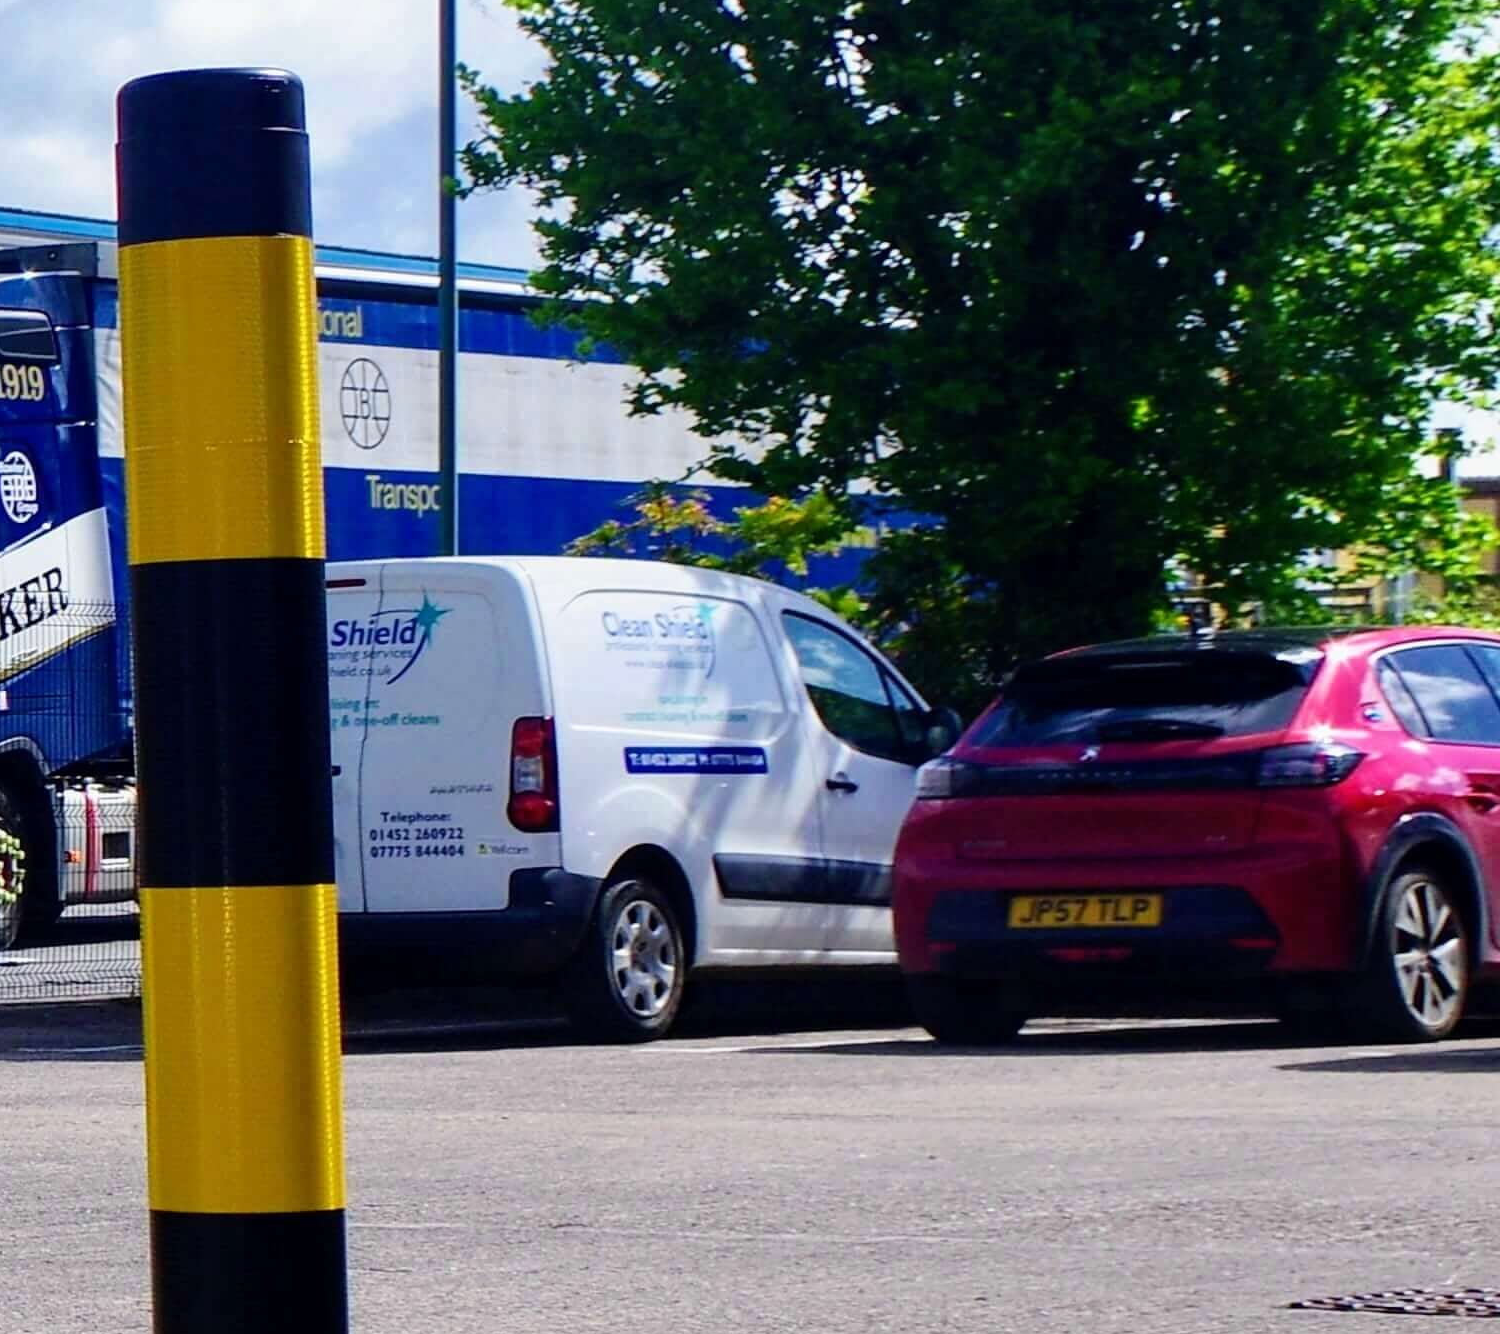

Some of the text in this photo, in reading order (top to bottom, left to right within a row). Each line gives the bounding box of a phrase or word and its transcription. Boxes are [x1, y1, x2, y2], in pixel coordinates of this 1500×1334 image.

[317, 305, 363, 337] ional
[331, 618, 418, 647] Shield
[380, 811, 452, 826] Telephone:
[370, 827, 464, 841] 01452 260922
[370, 845, 465, 858] 07775 844404
[1018, 897, 1150, 924] JP57 TLP
